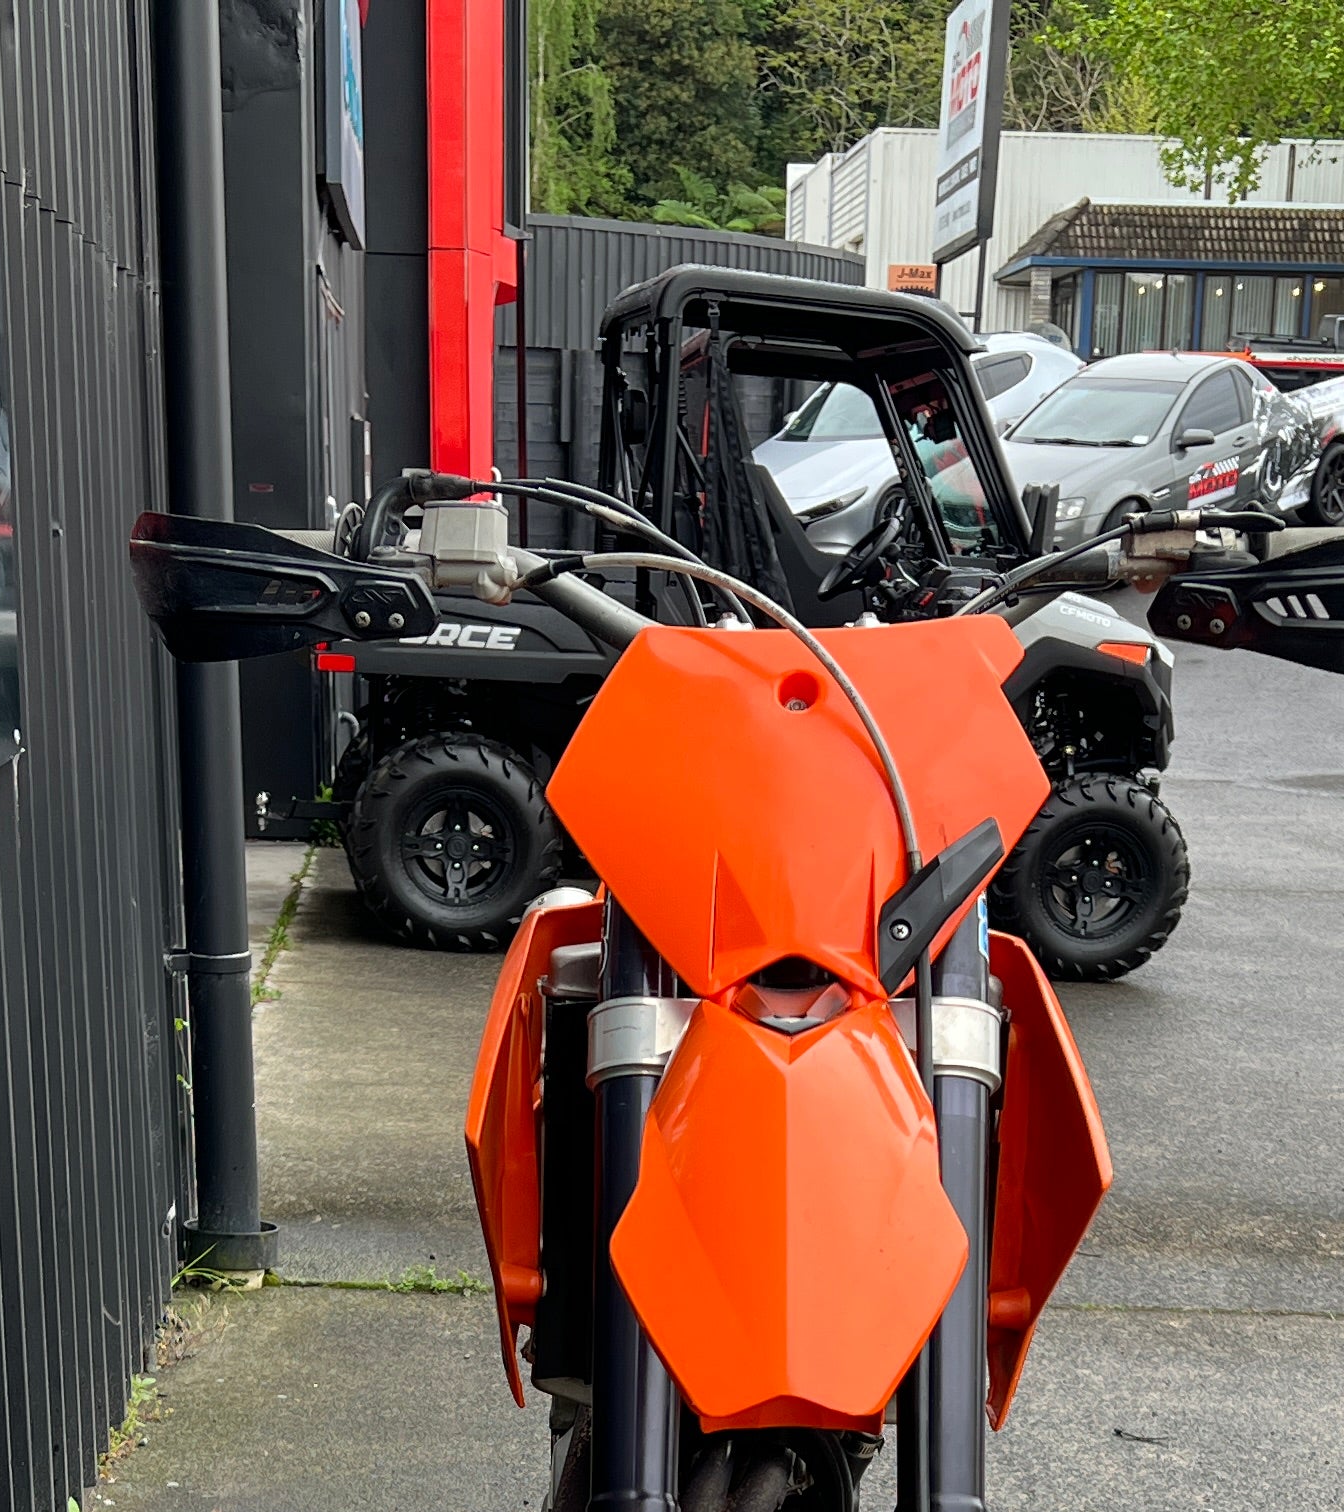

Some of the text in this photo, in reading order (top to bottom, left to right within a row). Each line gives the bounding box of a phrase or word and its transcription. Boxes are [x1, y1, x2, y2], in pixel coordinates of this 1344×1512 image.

[896, 267, 934, 279] J-Max
[1188, 469, 1239, 500] MOTO
[1059, 605, 1111, 628] CFMOTO
[398, 622, 522, 651] RCE
